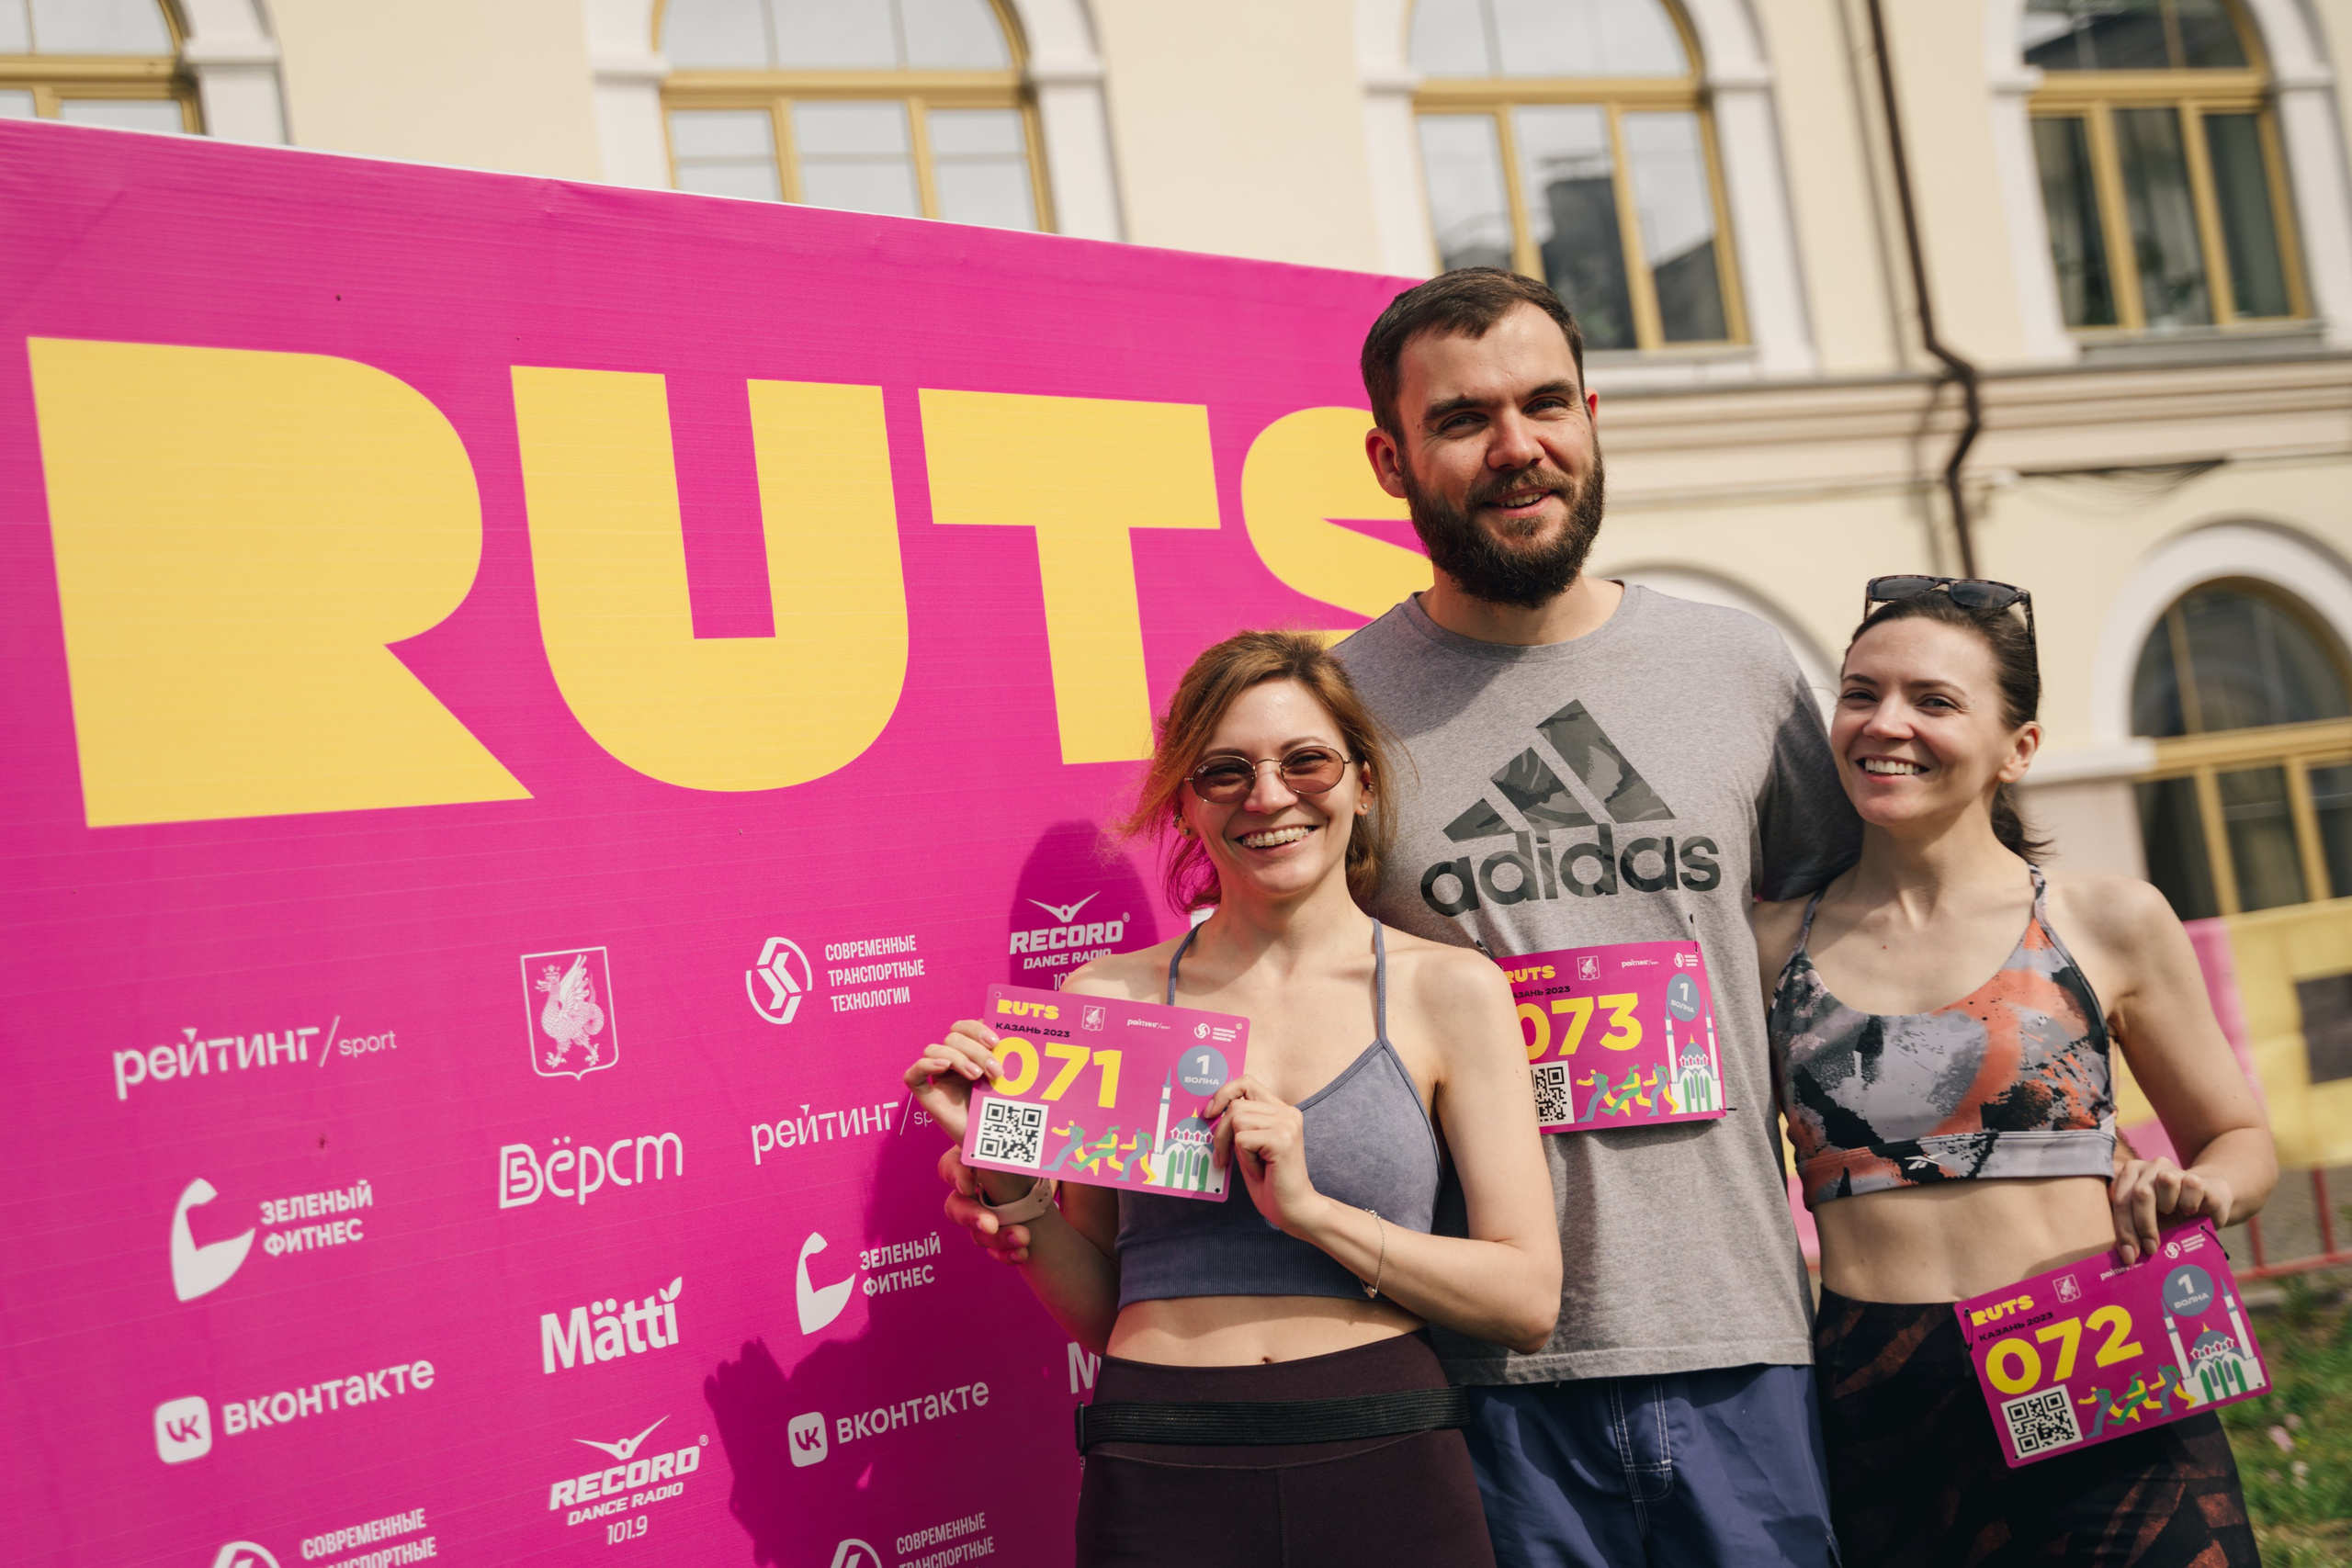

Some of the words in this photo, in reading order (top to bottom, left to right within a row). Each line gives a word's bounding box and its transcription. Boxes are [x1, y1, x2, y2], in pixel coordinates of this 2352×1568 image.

[1420, 823, 1721, 917] adidas
[825, 934, 916, 962] СОВРЕМЕННЫЕ
[1023, 953, 1069, 969] DANCE
[828, 958, 925, 987] ТРАНСПОРТНЫЕ
[1504, 965, 1555, 984] RUTS
[831, 986, 910, 1013] ТЕХНОЛОГИИ
[1513, 989, 1544, 998] АЗАНЬ
[1545, 986, 1571, 995] 2023
[1670, 998, 1695, 1014] ВОЛНА
[1679, 983, 1690, 1002] 1
[997, 999, 1059, 1020] RUTS
[995, 1021, 1042, 1035] КАЗАНЬ
[1043, 1028, 1070, 1038] 2023
[1517, 993, 1643, 1060] 073
[988, 1037, 1123, 1109] 071
[1196, 1055, 1210, 1075] 1
[1184, 1076, 1220, 1086] ВОЛНА
[260, 1179, 373, 1225] ЗЕЛЕНЫЙ
[263, 1218, 364, 1256] ФИТНЕС
[859, 1232, 942, 1270] ЗЕЛЕНЫЙ
[862, 1264, 934, 1297] ФИТНЕС
[2177, 1273, 2195, 1295] 1
[1971, 1294, 2034, 1326] RUTS
[2173, 1292, 2210, 1309] ВОЛНА
[540, 1277, 683, 1374] Mätti
[1979, 1320, 2025, 1342] КАЗАНЬ
[2026, 1311, 2054, 1325] 2023
[1985, 1305, 2143, 1394] 072
[567, 1496, 629, 1527] DANCE
[631, 1482, 684, 1510] RADIO
[302, 1507, 426, 1561] СОВРЕМЕННЫЕ
[605, 1516, 649, 1545] 101.9
[896, 1512, 986, 1554] СОВРЕМЕННЫЕ
